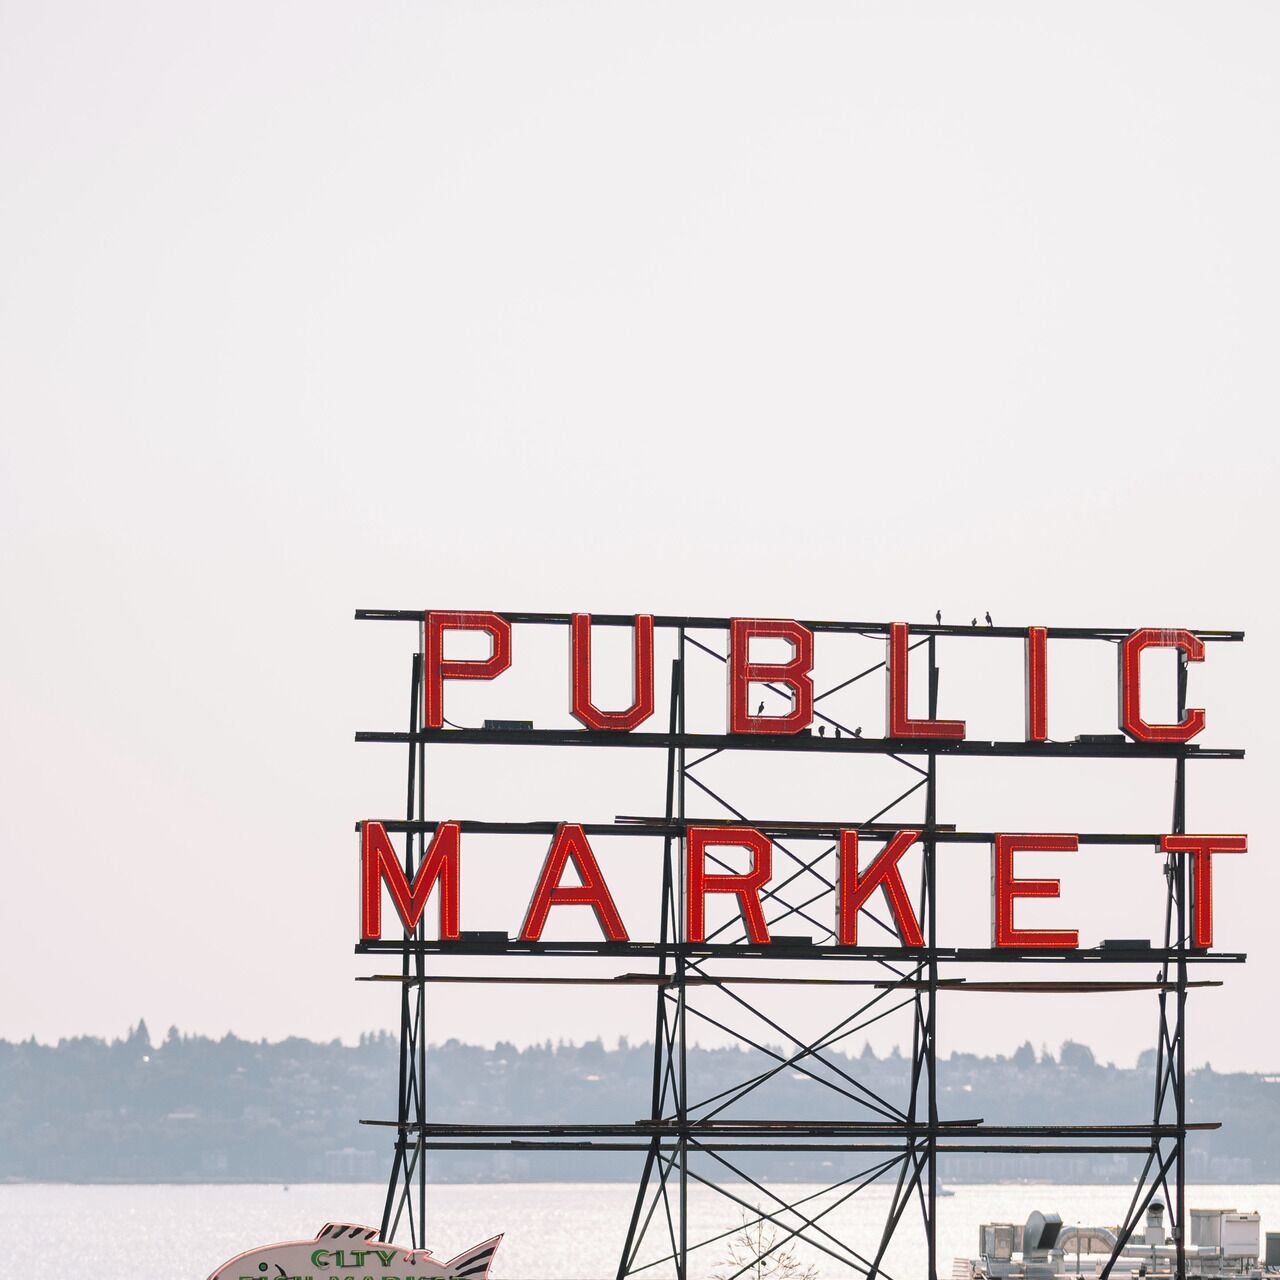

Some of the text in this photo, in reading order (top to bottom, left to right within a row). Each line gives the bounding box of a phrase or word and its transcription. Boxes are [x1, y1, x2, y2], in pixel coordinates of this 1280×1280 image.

[423, 610, 1207, 743] PUBLIC
[359, 821, 1249, 949] MARKET
[310, 1249, 398, 1268] CITY
